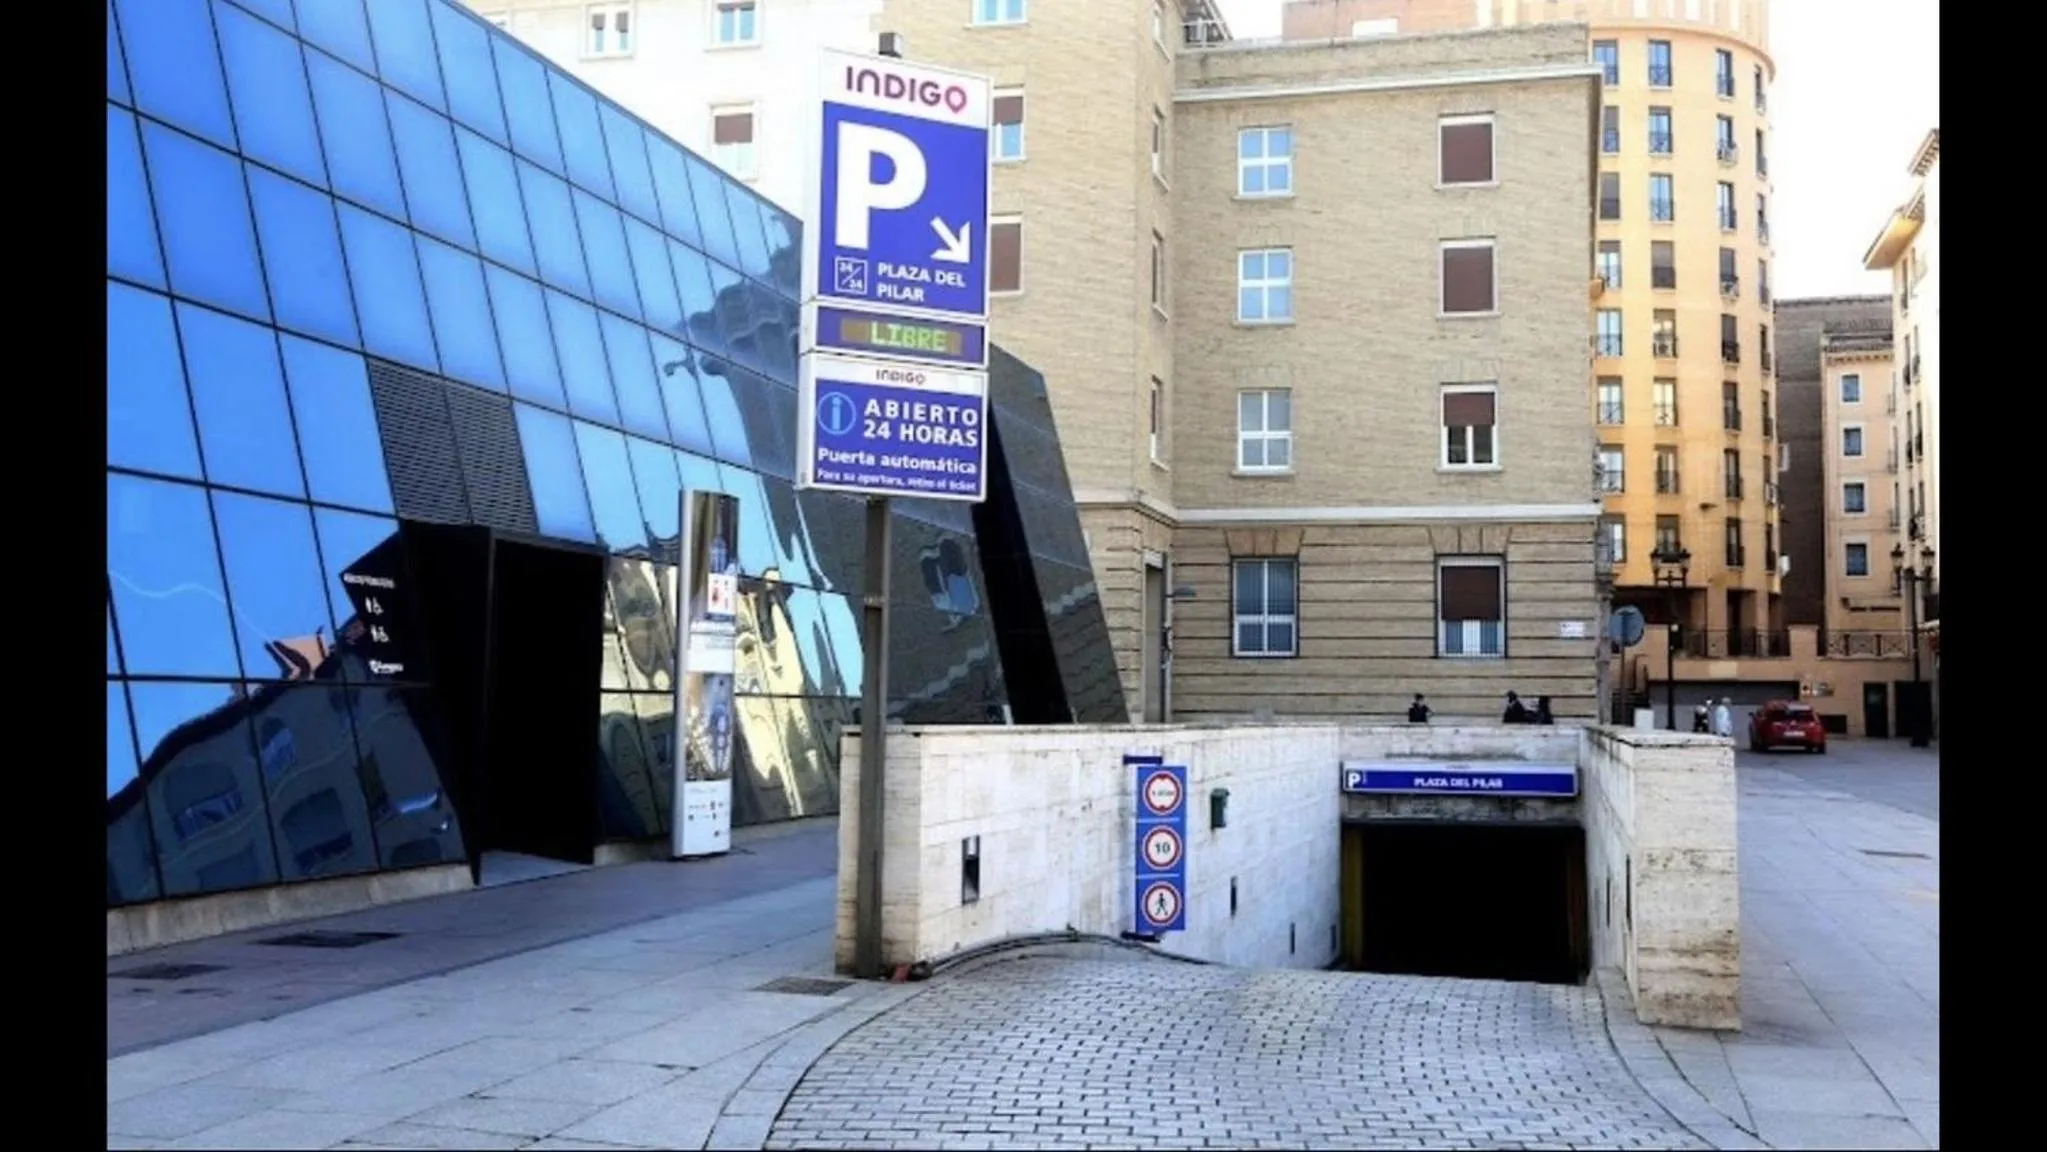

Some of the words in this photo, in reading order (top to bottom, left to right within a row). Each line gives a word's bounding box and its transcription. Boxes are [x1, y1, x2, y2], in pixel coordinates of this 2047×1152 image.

[847, 66, 967, 113] INDIGO
[835, 120, 927, 250] P
[878, 262, 931, 282] PLAZA
[935, 269, 966, 288] DEL
[877, 283, 924, 302] PILAR
[870, 321, 948, 351] LIBRE
[876, 369, 927, 386] INDIGO
[864, 399, 978, 426] ABIERTO
[864, 421, 891, 440] 24
[900, 424, 978, 447] HORAS
[818, 448, 875, 467] Puerta
[881, 453, 976, 474] automática
[1348, 771, 1361, 788] P
[1414, 778, 1448, 788] PLAZA
[1450, 778, 1469, 788] DEL
[1472, 778, 1503, 789] PILAR
[1155, 843, 1170, 855] 10
